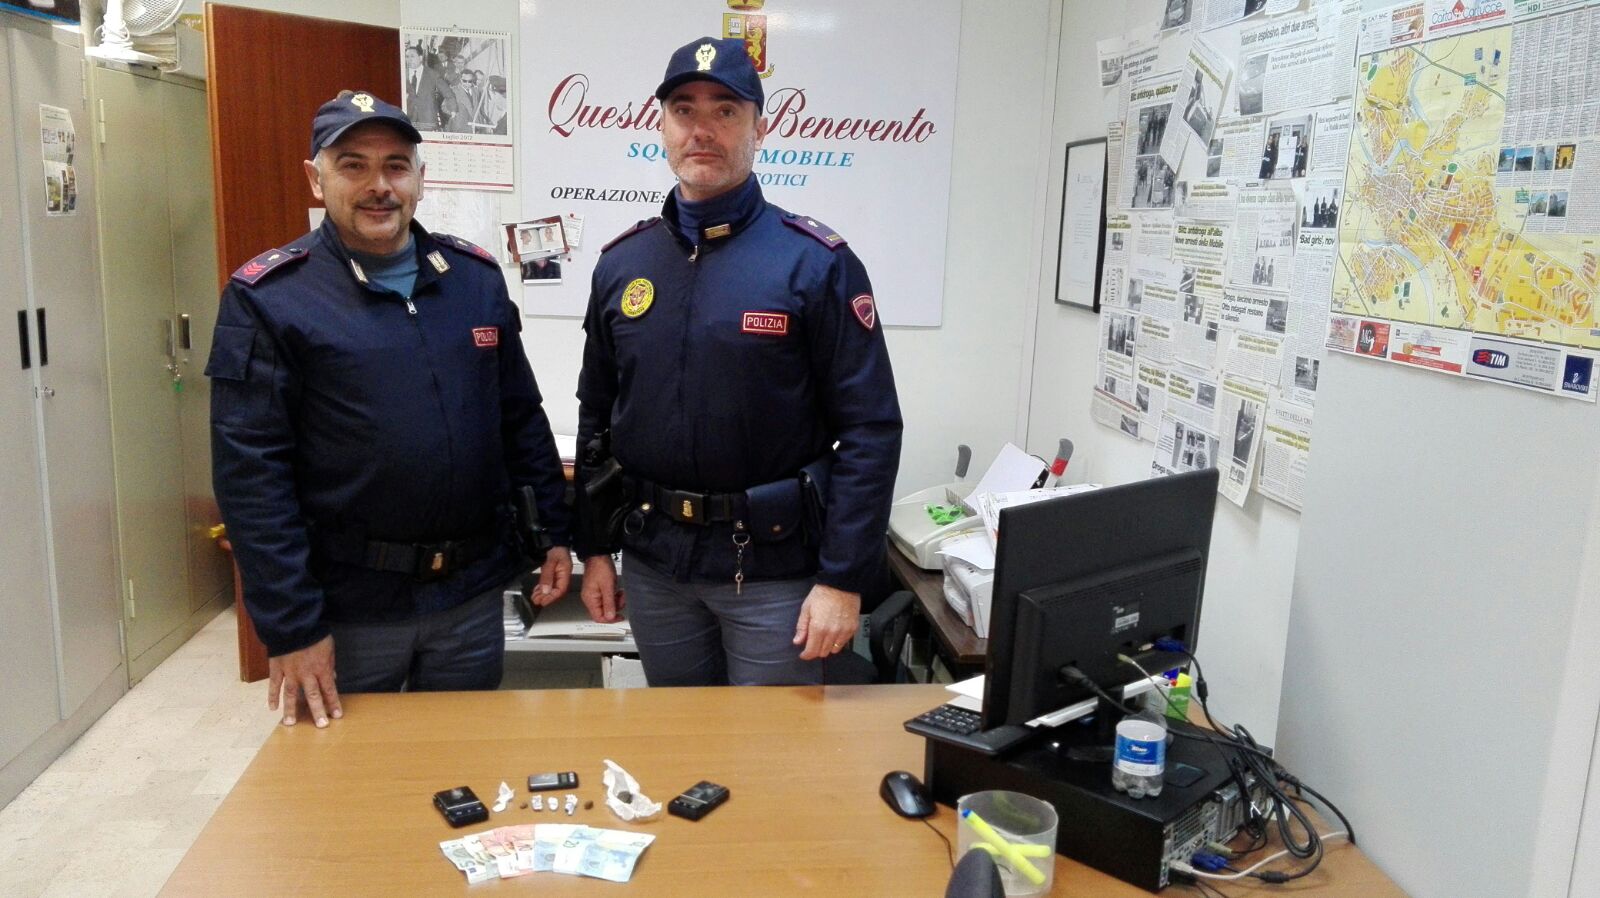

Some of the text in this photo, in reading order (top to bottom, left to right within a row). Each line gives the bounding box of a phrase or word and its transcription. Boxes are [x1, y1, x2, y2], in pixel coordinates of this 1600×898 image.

[1291, 21, 1301, 33] due
[548, 73, 937, 143] Questu Benevento
[759, 149, 855, 167] MOBILE
[551, 186, 666, 203] OPERAZIONE:
[1209, 239, 1224, 249] Mobile
[746, 316, 783, 329] POLIZIA
[1490, 353, 1507, 367] TIM
